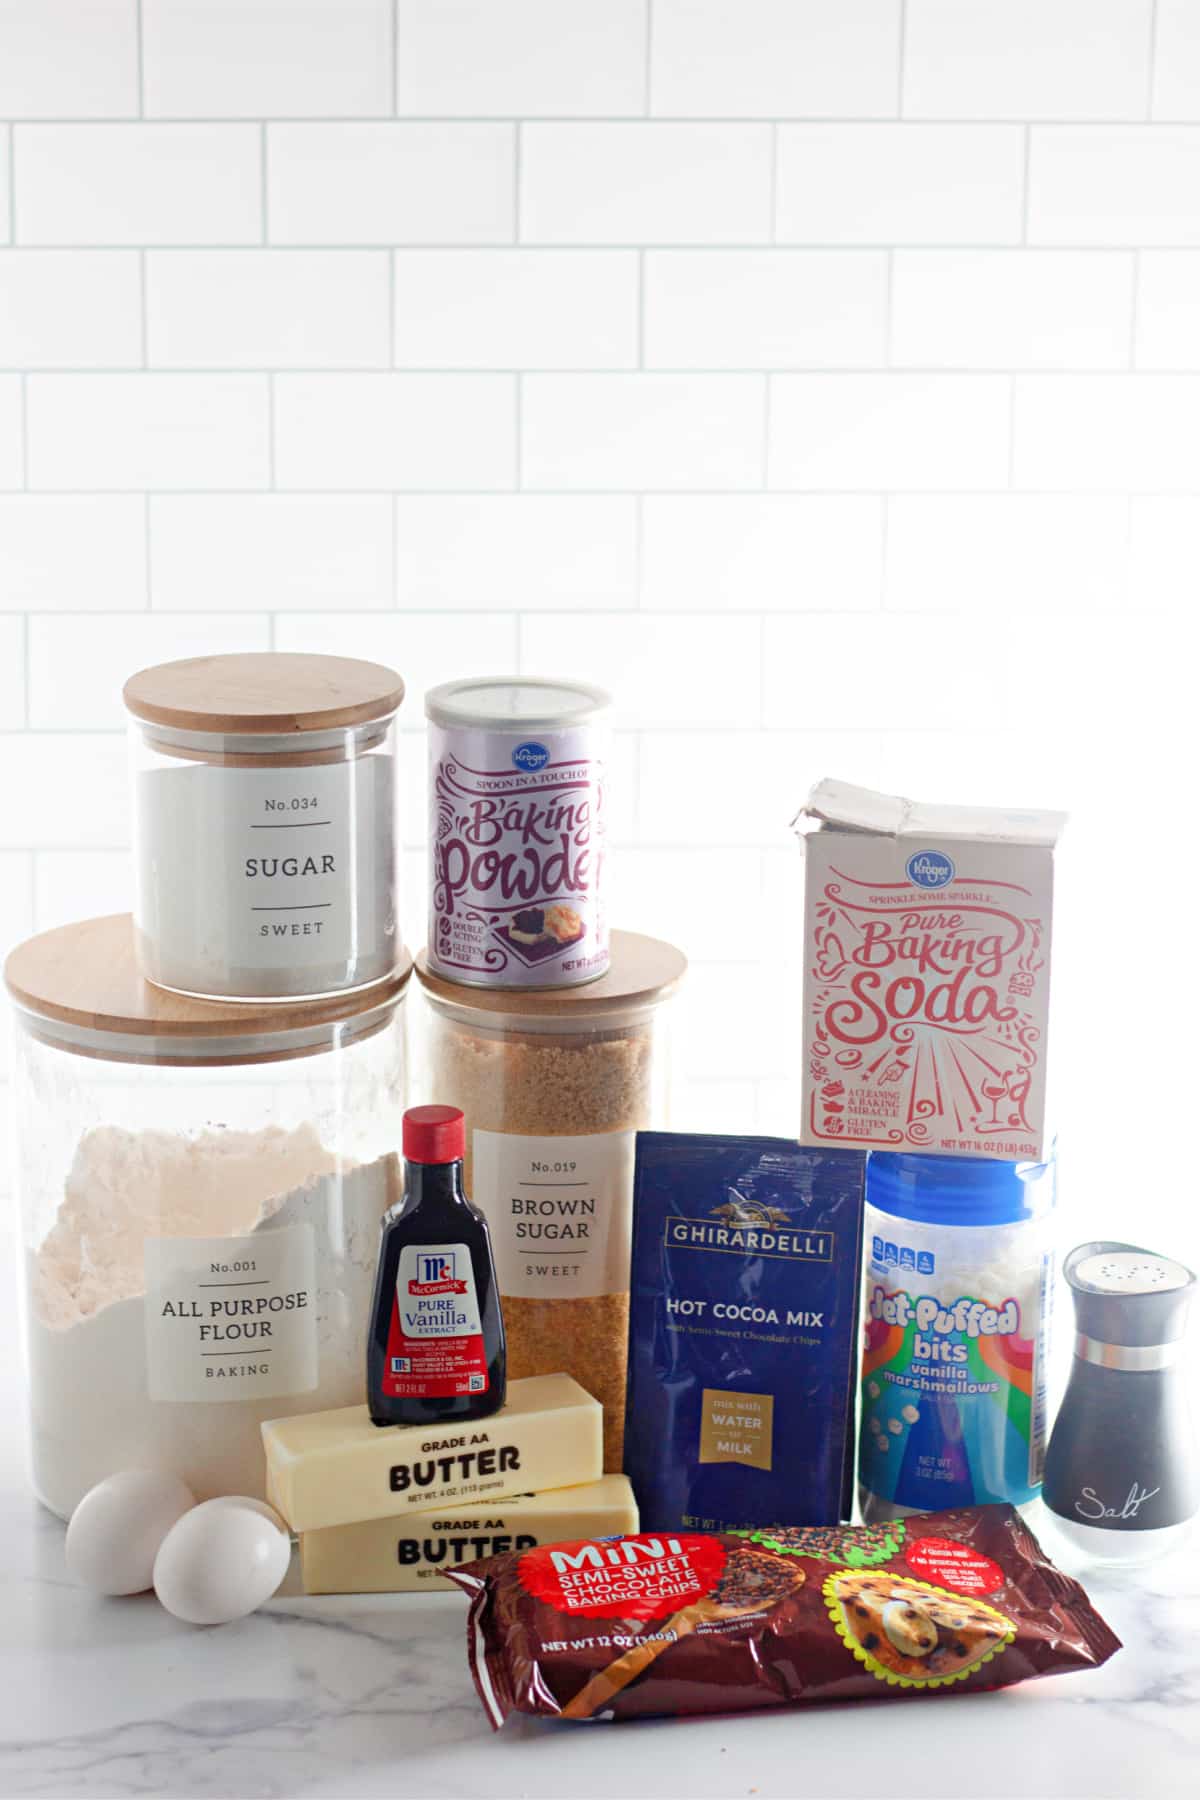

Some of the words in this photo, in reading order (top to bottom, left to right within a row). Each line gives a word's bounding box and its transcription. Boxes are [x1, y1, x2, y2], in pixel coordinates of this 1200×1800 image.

[515, 748, 546, 767] Kroger
[476, 780, 513, 789] SPOON
[515, 776, 528, 787] IN
[541, 770, 577, 782] TOUCH
[264, 797, 319, 811] No.034
[465, 799, 591, 847] Baking
[245, 855, 336, 877] SUGAR
[914, 856, 949, 882] Kroger
[868, 895, 915, 904] SPRINKLE
[917, 892, 945, 901] SOME
[260, 922, 323, 936] SWEET
[900, 912, 964, 934] Pure
[852, 921, 1010, 978] Baking
[825, 966, 1019, 1045] Soda
[848, 1106, 899, 1117] MIRACLE
[848, 1119, 887, 1129] GLUTEN
[848, 1128, 872, 1136] FREE
[941, 1139, 957, 1150] NET
[959, 1140, 973, 1151] WT
[984, 1142, 996, 1152] OZ
[531, 1162, 577, 1173] No.019
[511, 1198, 597, 1216] BROWN
[516, 1222, 590, 1239] SUGAR
[673, 1224, 825, 1255] GHIRARDELLI
[210, 1261, 257, 1273] No.001
[525, 1265, 581, 1276] SWEET
[411, 1282, 461, 1295] McCormick
[161, 1301, 203, 1317] ALL
[210, 1292, 308, 1318] PURPOSE
[418, 1299, 456, 1312] PURE
[666, 1298, 707, 1316] HOT
[713, 1304, 779, 1325] COCOA
[786, 1312, 824, 1328] MIX
[870, 1286, 1020, 1338] Jet-Puffed
[405, 1310, 467, 1327] Vanilla
[200, 1321, 273, 1341] FLOUR
[914, 1334, 969, 1362] bits
[206, 1364, 270, 1378] BAKING
[911, 1363, 968, 1379] vanilla
[883, 1370, 1000, 1394] marshmallows
[712, 1413, 762, 1428] WATER
[421, 1437, 466, 1453] GRADE
[470, 1433, 490, 1445] AA
[717, 1441, 753, 1455] MILK
[389, 1445, 521, 1492] BUTTER
[408, 1495, 422, 1503] NET
[1075, 1482, 1160, 1519] Salt
[432, 1520, 480, 1530] GRADE
[484, 1519, 505, 1529] AA
[564, 1569, 697, 1598] CHOCOLATE
[567, 1591, 641, 1608] BAKING
[646, 1580, 701, 1598] CHIPS
[541, 1641, 568, 1652] NET
[570, 1638, 594, 1650] WT
[597, 1636, 612, 1647] 12
[613, 1635, 634, 1648] OZ
